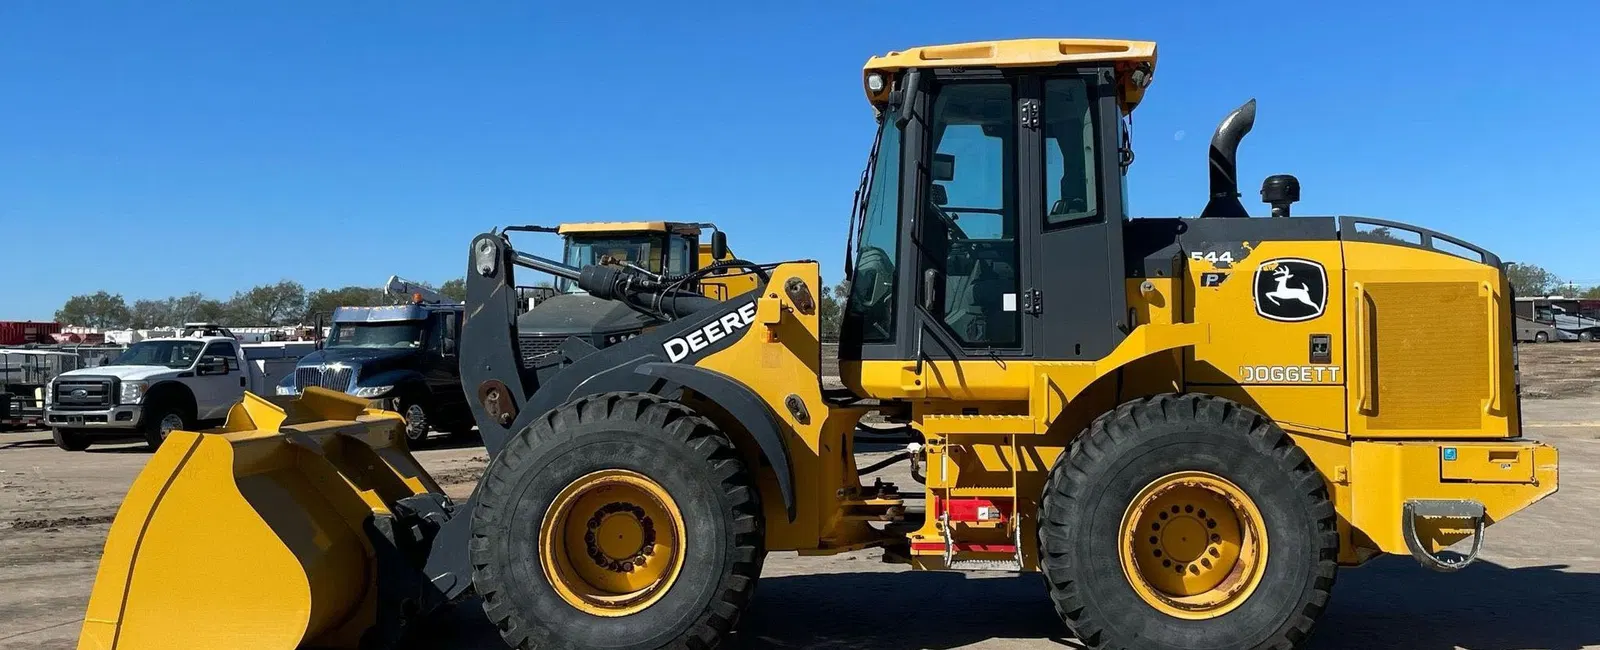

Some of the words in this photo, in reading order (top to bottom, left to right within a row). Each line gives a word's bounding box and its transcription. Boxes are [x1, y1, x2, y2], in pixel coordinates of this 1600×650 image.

[1191, 251, 1234, 263] 544
[1206, 274, 1219, 287] P
[663, 302, 756, 363] DEERE
[1239, 366, 1341, 382] DOGGETT
